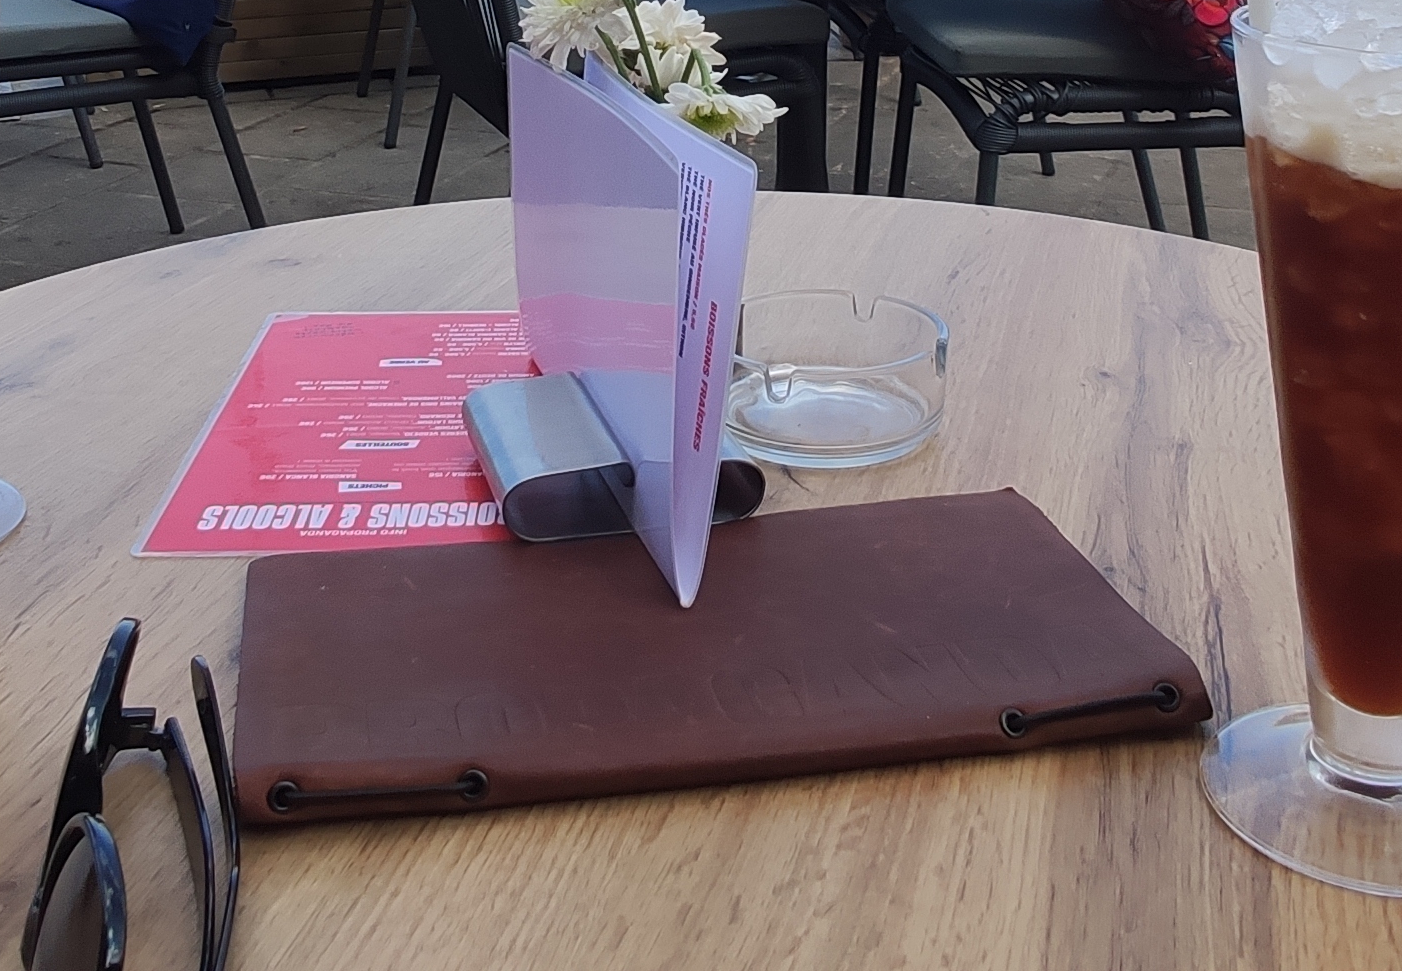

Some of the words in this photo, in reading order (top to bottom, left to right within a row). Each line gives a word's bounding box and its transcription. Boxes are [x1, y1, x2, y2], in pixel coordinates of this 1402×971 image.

[701, 300, 718, 378] BOISSONS
[692, 379, 709, 453] FRAÎCHES
[195, 502, 335, 532] ALCOOLS
[340, 504, 363, 529] &
[298, 528, 378, 537] PROPAGANDA
[379, 528, 408, 536] INFO
